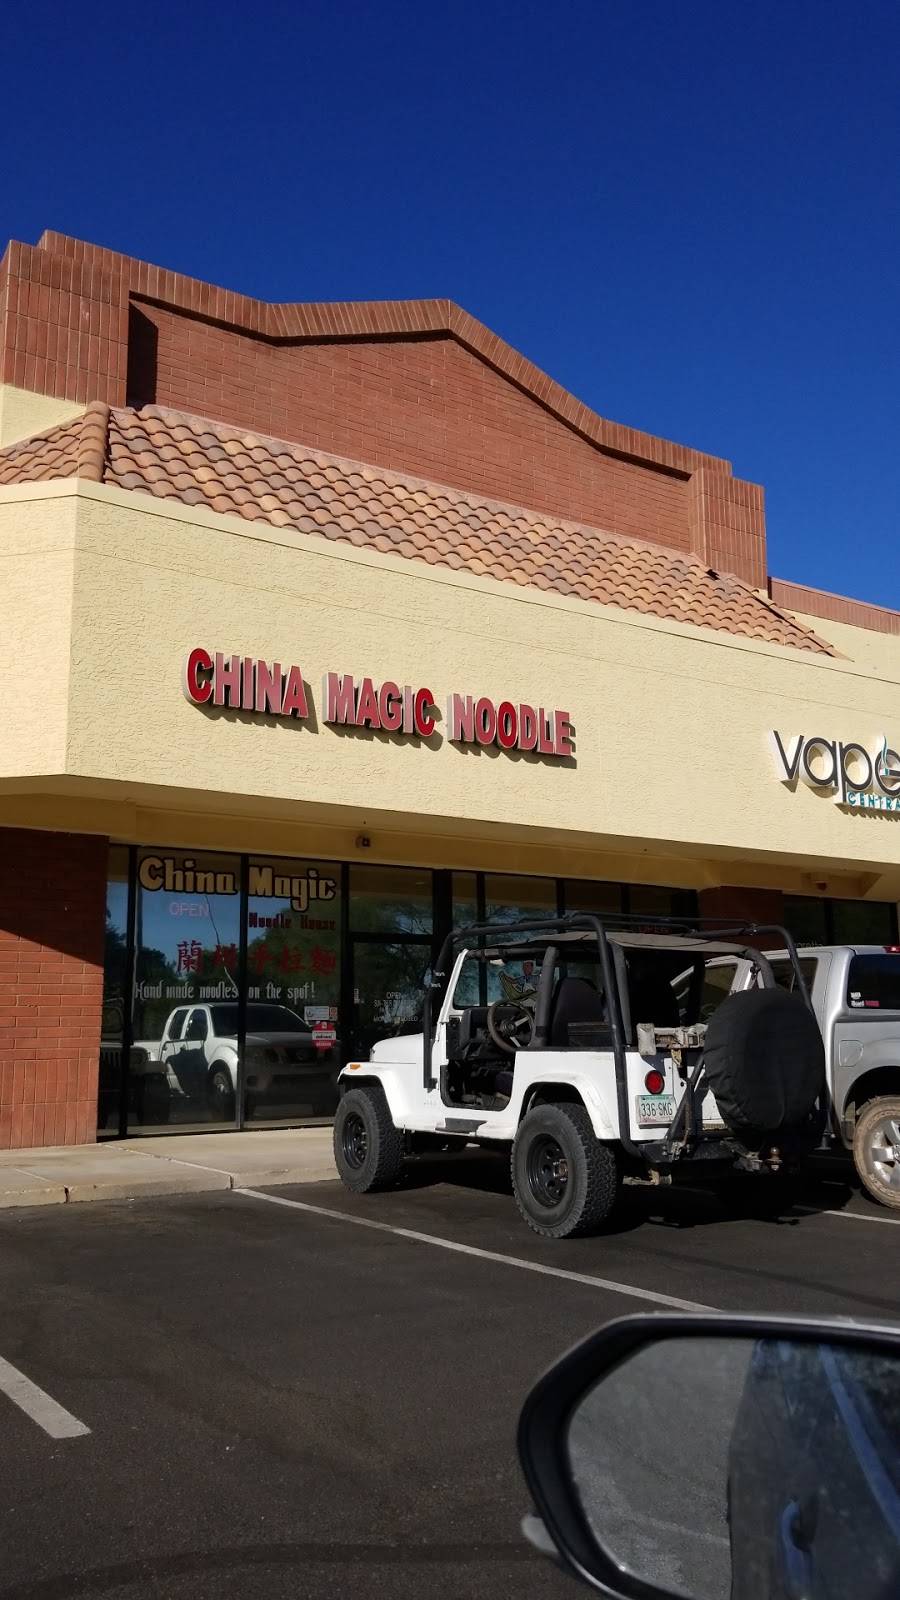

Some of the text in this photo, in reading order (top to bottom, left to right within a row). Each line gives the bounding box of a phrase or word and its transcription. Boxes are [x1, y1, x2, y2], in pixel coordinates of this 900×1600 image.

[185, 648, 572, 757] CHINA MAGIC NOODLE
[138, 855, 337, 913] China Magic
[168, 902, 210, 917] OPEN
[135, 980, 164, 1001] Hand
[165, 981, 194, 999] made
[199, 981, 239, 999] noodles
[248, 985, 261, 999] on
[265, 981, 282, 999] the
